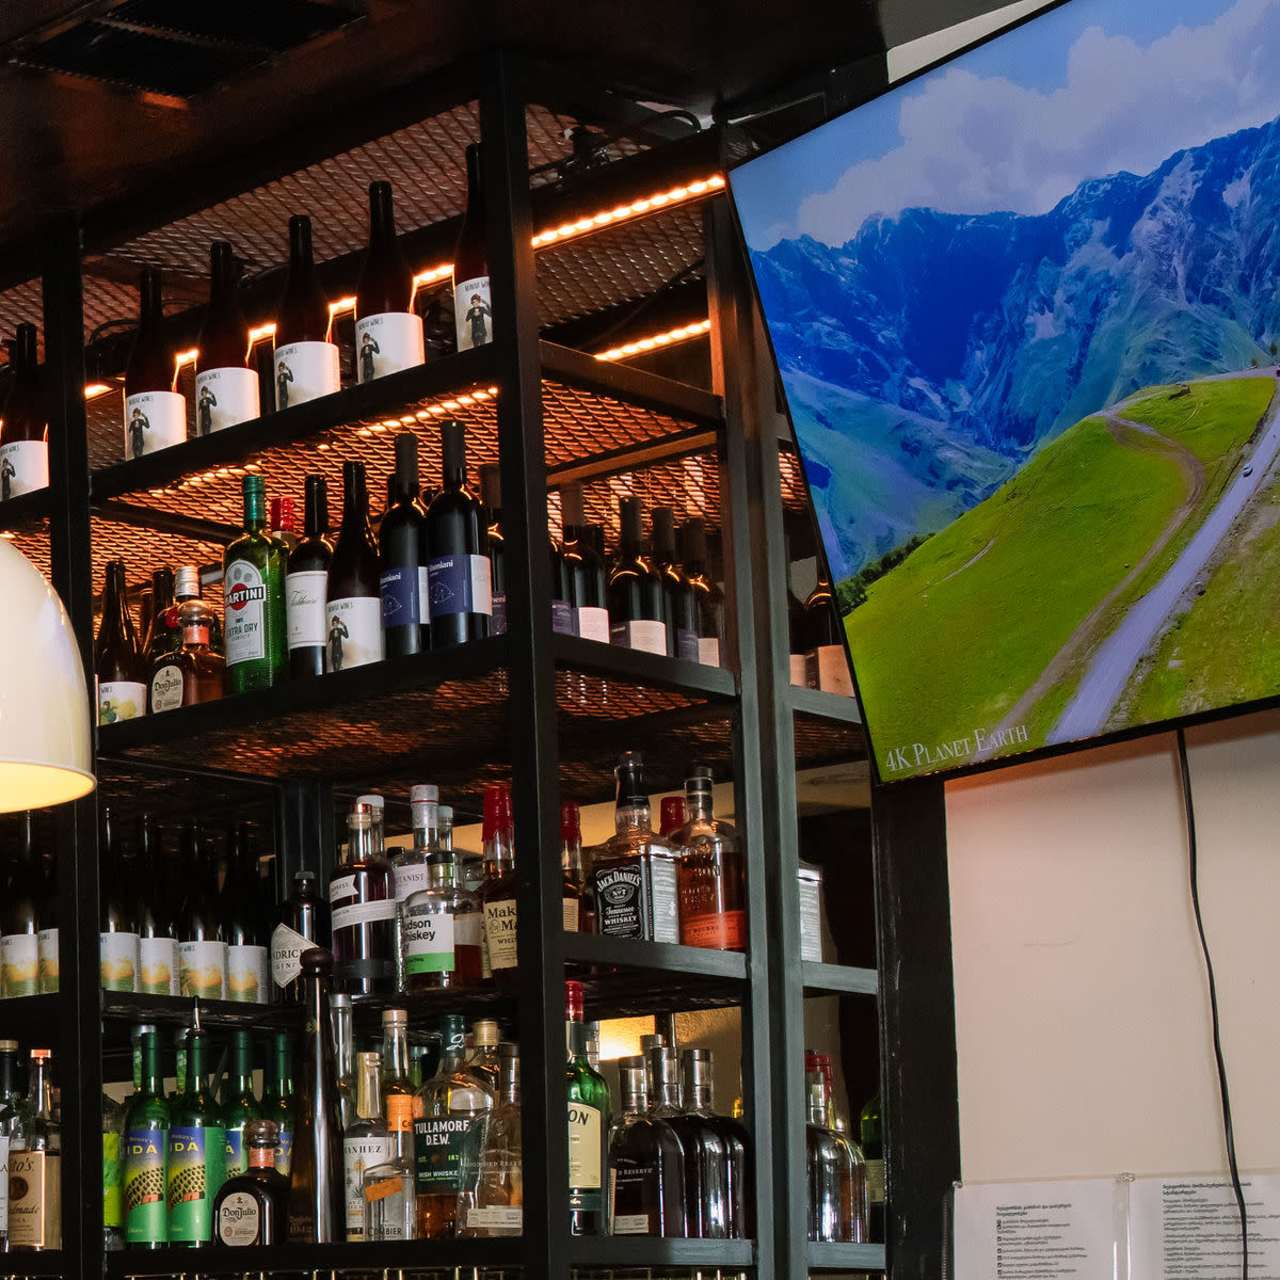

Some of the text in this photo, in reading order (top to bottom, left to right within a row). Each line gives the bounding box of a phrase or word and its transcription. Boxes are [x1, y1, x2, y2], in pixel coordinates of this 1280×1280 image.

[886, 745, 912, 771] 4K
[487, 906, 517, 919] Mak
[604, 914, 638, 926] WHISKEY
[222, 1206, 257, 1220] Don Julio
